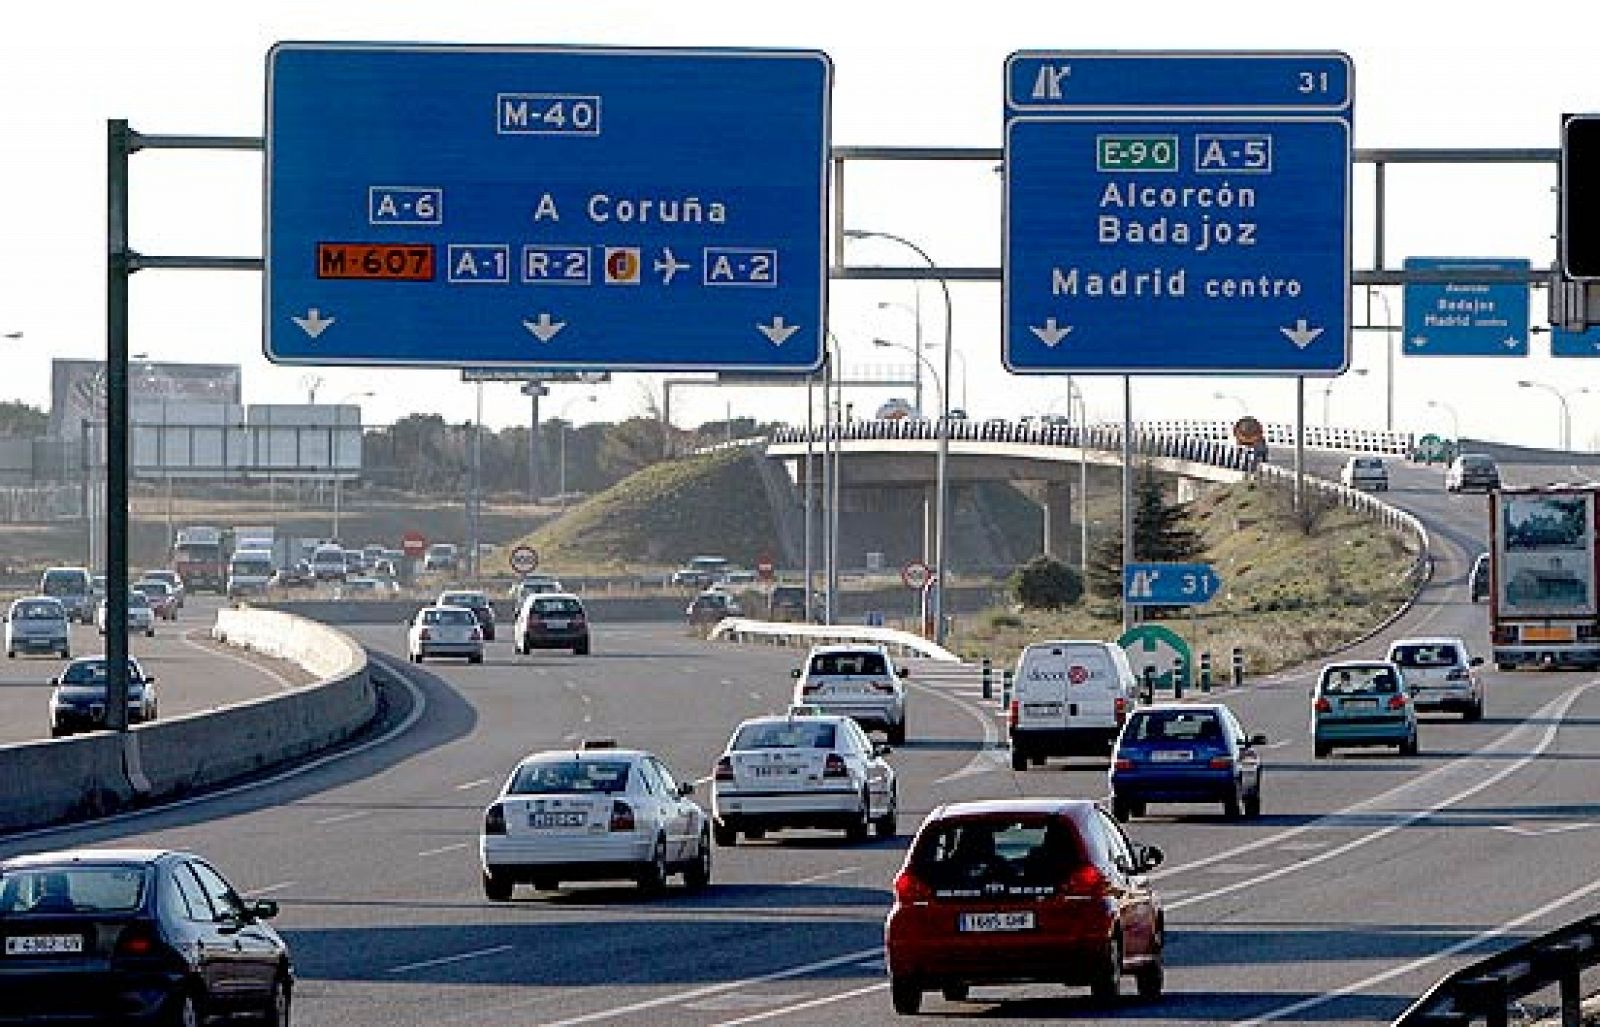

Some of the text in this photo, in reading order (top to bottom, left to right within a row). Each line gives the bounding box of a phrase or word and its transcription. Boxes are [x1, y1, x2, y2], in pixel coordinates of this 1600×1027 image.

[1297, 72, 1329, 94] 31
[505, 101, 592, 128] M-40
[1104, 142, 1171, 164] E-90
[1200, 139, 1267, 167] A-5
[377, 194, 436, 219] A-6
[1099, 181, 1256, 207] Alcorcón
[534, 194, 727, 223] A Coruña
[1099, 214, 1257, 251] Badajoz
[322, 249, 427, 275] M-607
[455, 250, 504, 277] A-1
[528, 252, 586, 278] R-2
[710, 255, 770, 280] A-2
[1052, 267, 1301, 298] Madrid centro
[1181, 573, 1208, 594] 31
